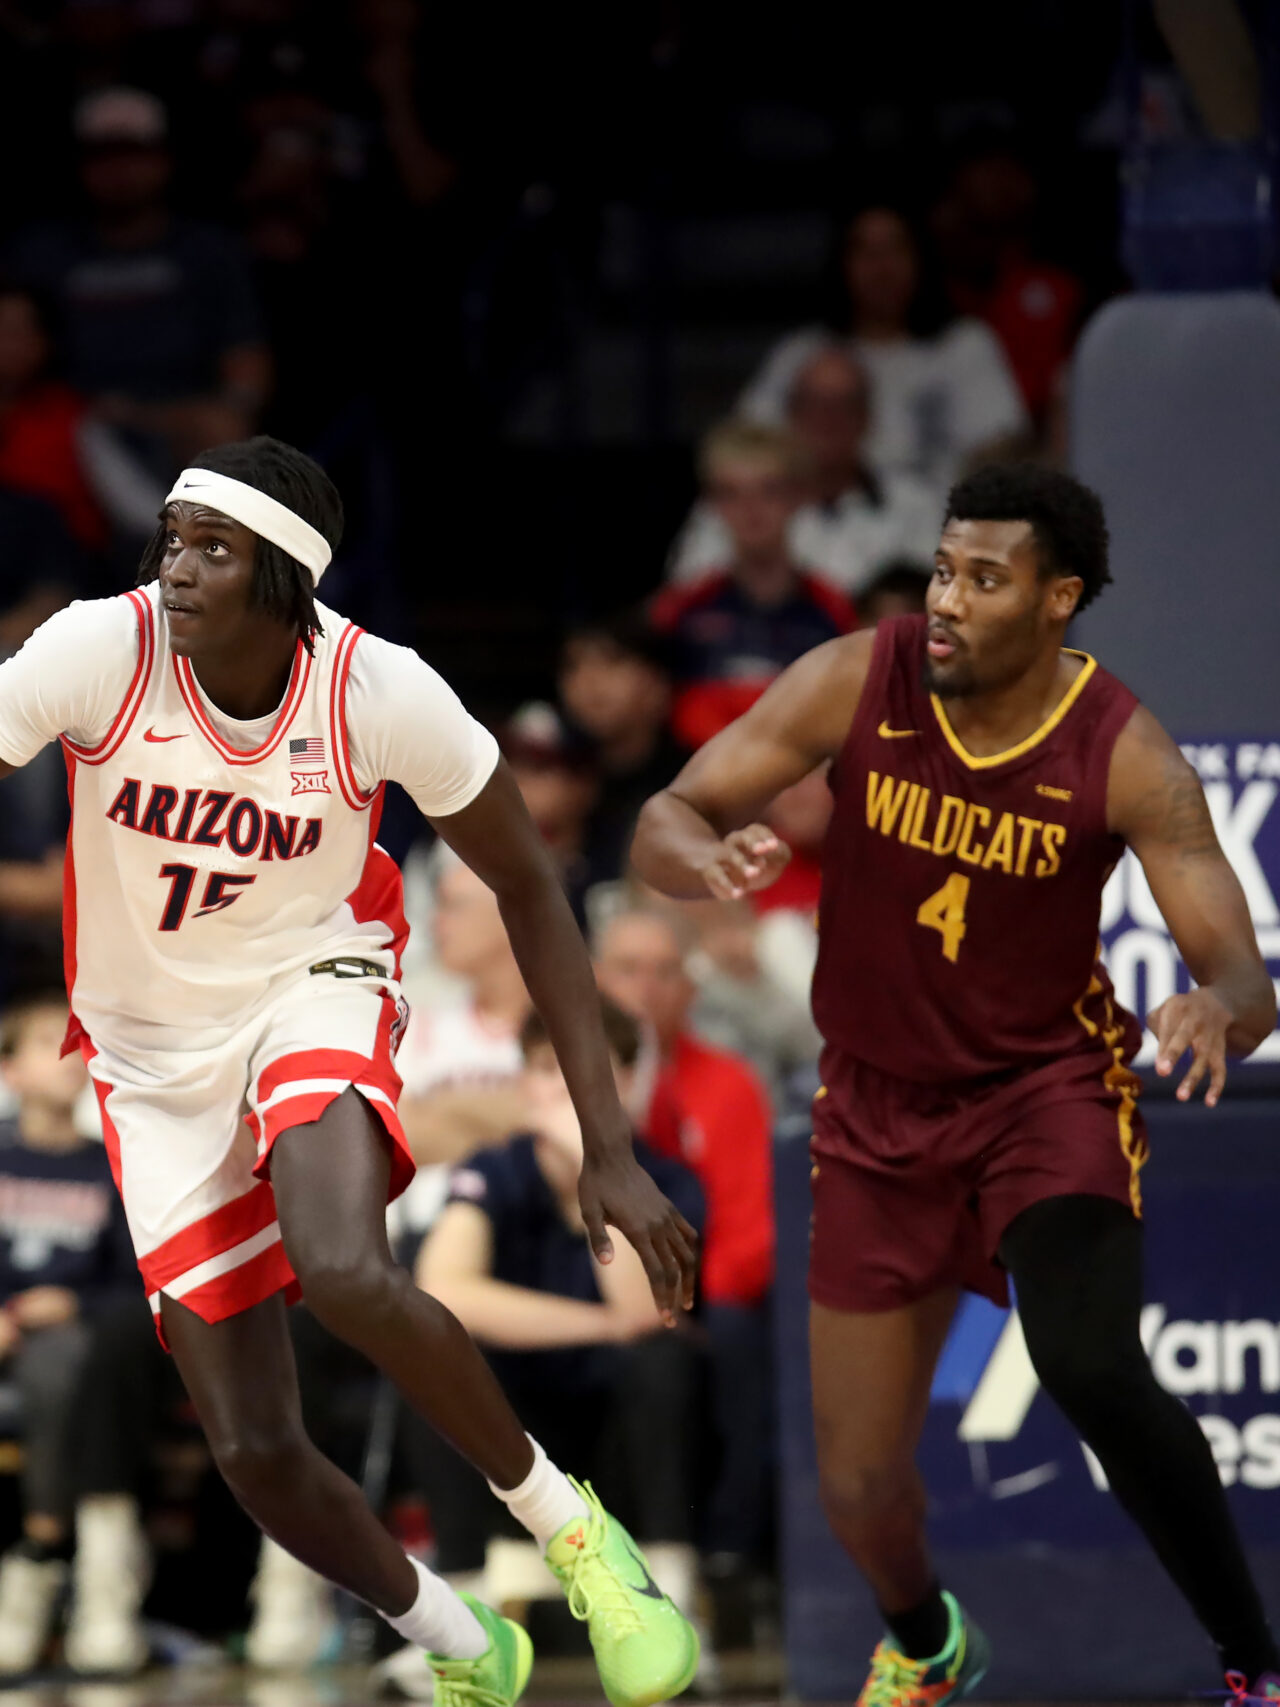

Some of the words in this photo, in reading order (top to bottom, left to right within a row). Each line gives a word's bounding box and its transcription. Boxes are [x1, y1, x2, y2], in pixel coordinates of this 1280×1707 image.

[106, 777, 322, 861] ARIZONA
[866, 770, 1067, 879] WILDCATS
[157, 862, 258, 932] 15
[916, 872, 970, 964] 4
